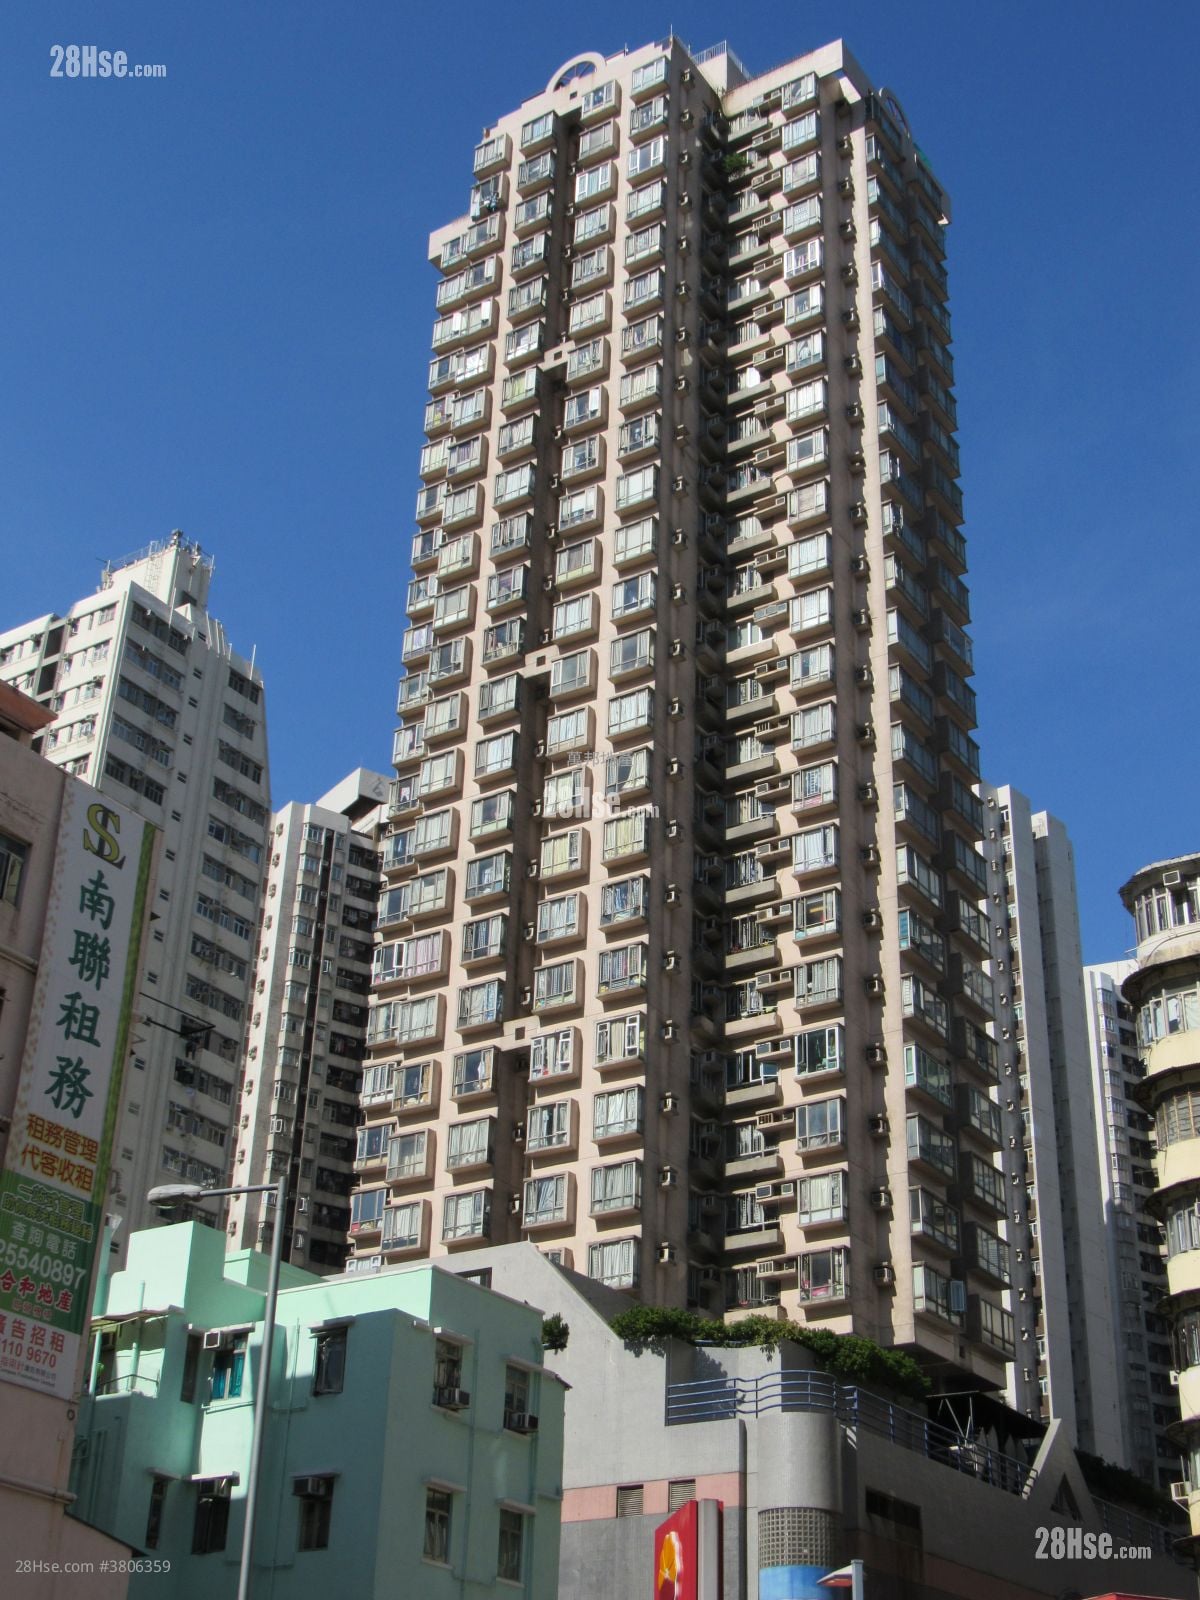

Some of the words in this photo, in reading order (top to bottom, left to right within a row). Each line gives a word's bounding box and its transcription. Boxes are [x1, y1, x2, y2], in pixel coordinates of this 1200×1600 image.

[44, 870, 116, 1120] 南聯租務
[26, 1113, 99, 1164] 租務管理
[21, 1142, 94, 1192] 代客收租
[0, 1238, 87, 1290] 25540897
[10, 1221, 77, 1260] 查詢電話
[26, 1346, 57, 1369] 9670
